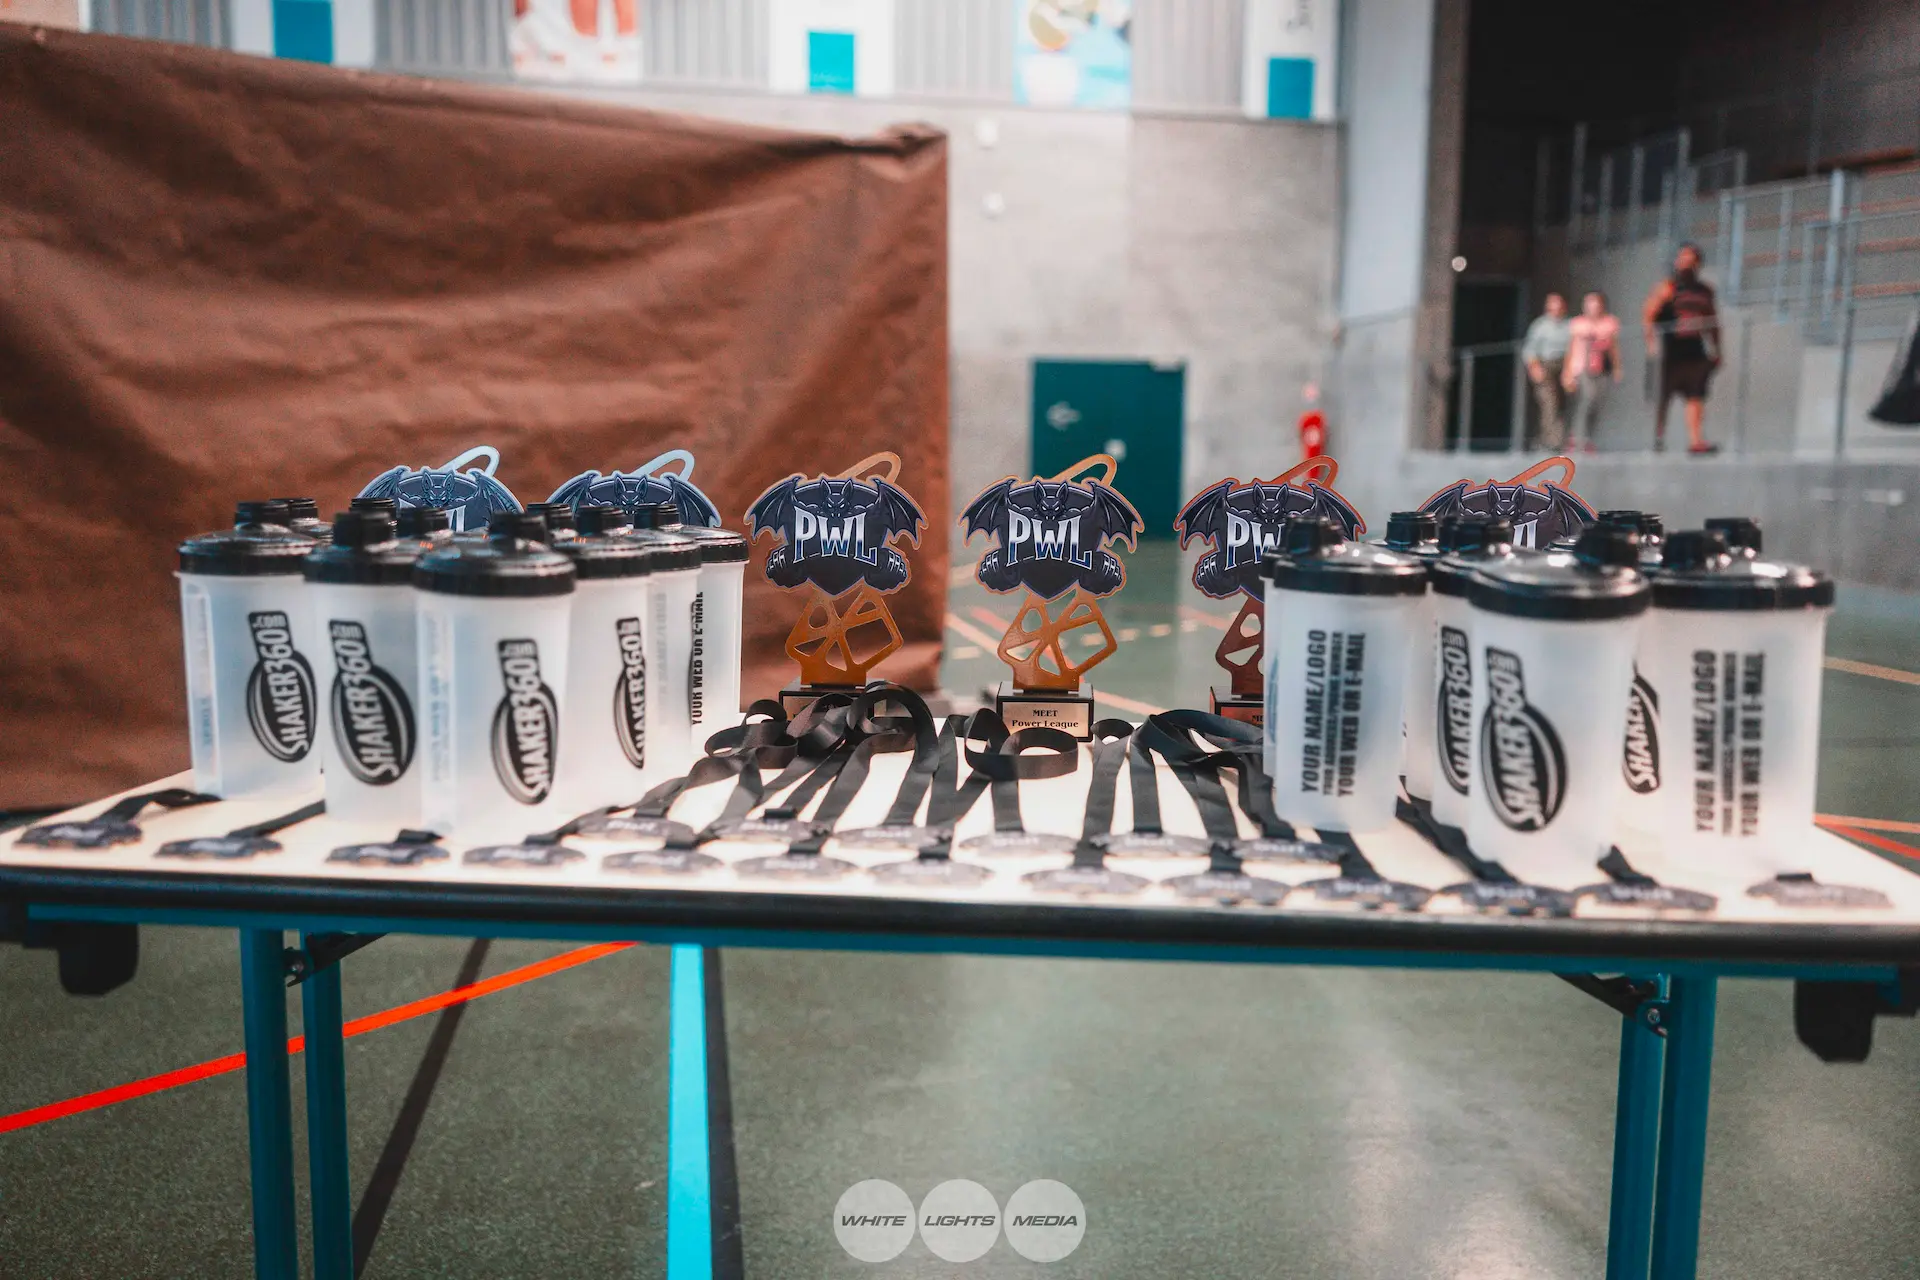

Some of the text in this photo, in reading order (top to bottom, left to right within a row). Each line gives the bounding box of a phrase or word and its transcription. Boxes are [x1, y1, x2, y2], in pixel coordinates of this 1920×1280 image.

[793, 506, 877, 566] PWL
[1005, 508, 1093, 570] PWL
[1224, 511, 1285, 571] PW
[255, 629, 309, 755] SHAKER360
[333, 639, 399, 778] SHAKER360
[1033, 709, 1058, 717] MEET
[1302, 630, 1327, 793] YOUR NAME/LOGO
[504, 657, 551, 797] SHAKER360
[1012, 719, 1079, 729] Power League
[1490, 670, 1545, 827] SHAKER360
[1337, 755, 1356, 797] YOUR
